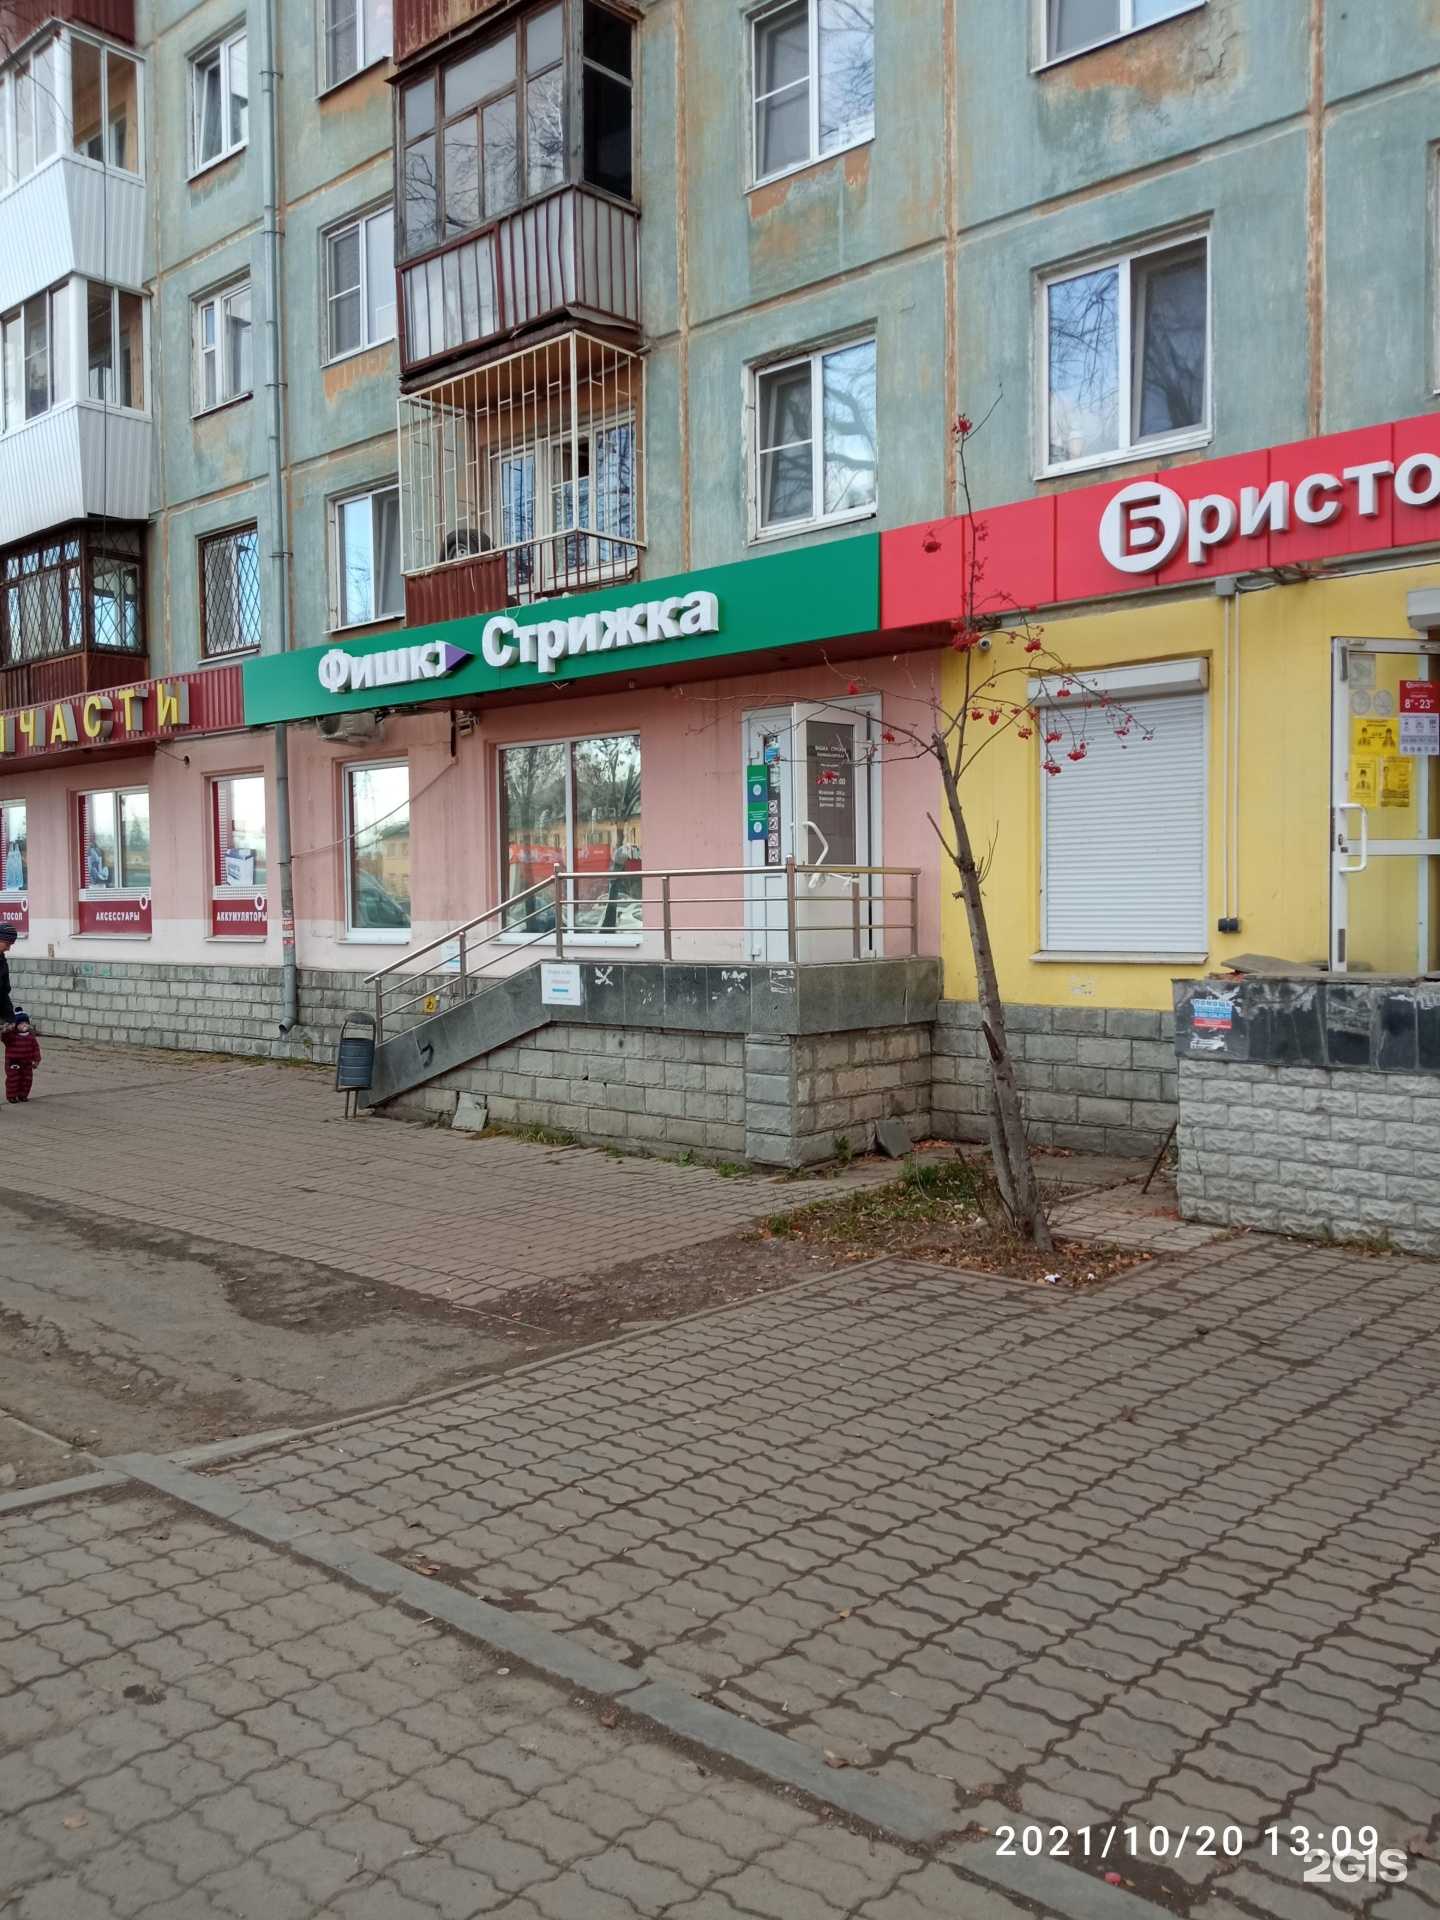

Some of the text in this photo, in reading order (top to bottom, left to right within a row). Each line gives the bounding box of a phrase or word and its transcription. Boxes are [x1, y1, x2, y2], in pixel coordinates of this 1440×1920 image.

[482, 590, 719, 673] Стрижка
[0, 678, 190, 752] ЧАСТИ
[95, 911, 140, 921] АКСЕССУАРЫ
[216, 911, 267, 922] АККУМУЛЯТОРЫ
